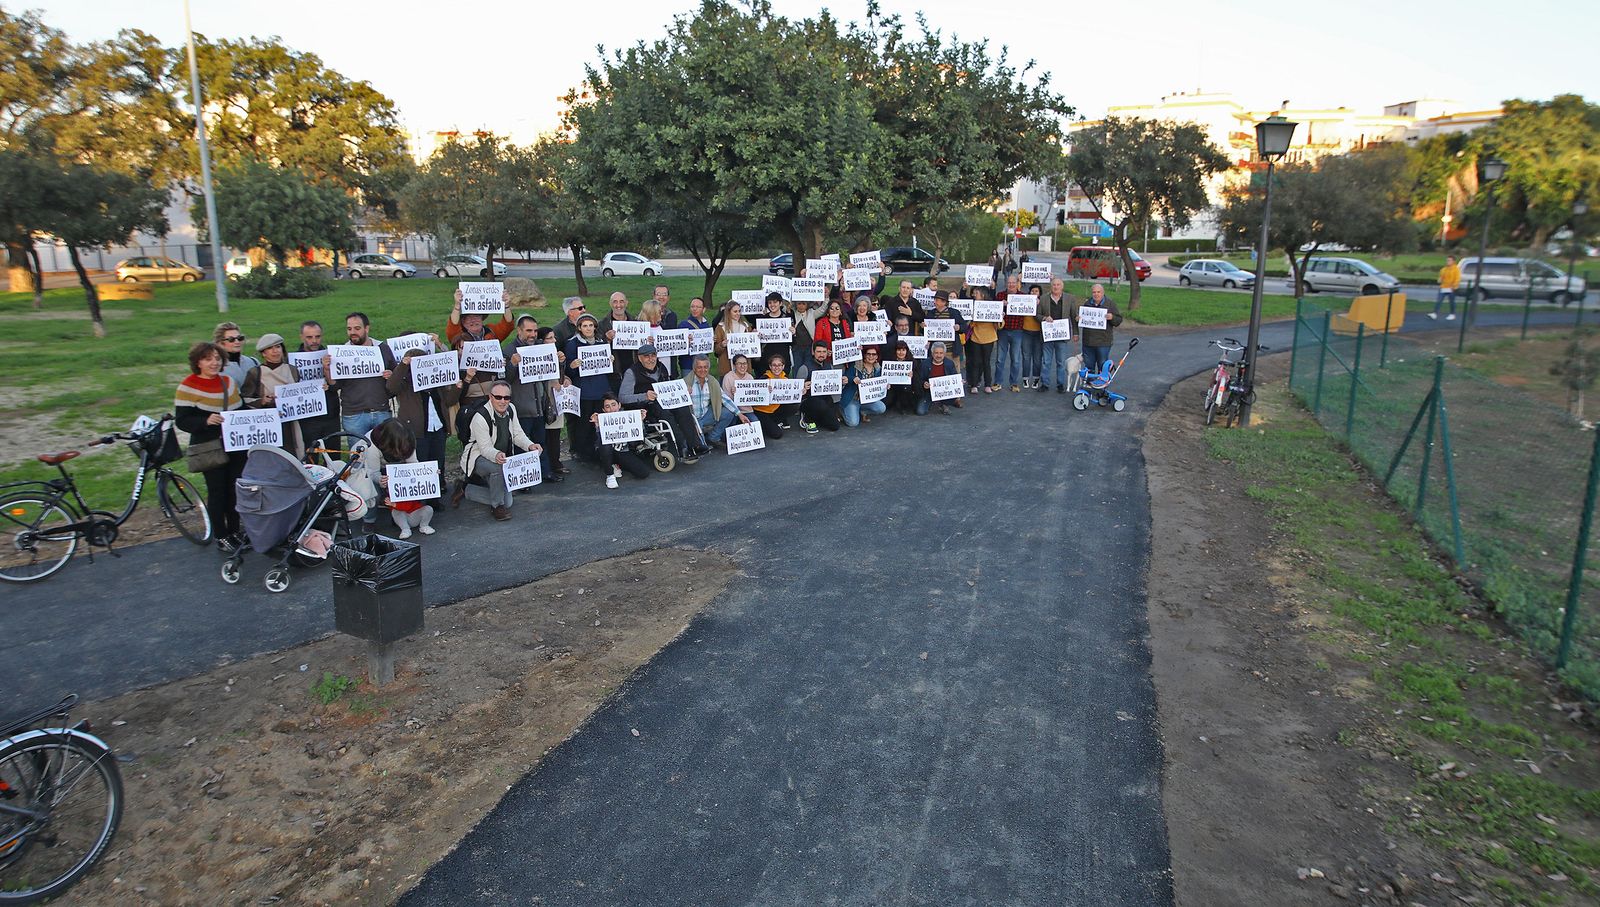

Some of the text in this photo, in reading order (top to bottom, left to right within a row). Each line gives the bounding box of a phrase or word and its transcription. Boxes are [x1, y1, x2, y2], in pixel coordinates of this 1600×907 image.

[466, 285, 500, 294] Zonas verdes
[464, 298, 501, 310] Sin asfalto
[745, 303, 763, 312] asfalto
[1018, 305, 1034, 313] asfalto
[985, 311, 1000, 319] asfalto
[617, 326, 637, 334] Albero
[936, 328, 952, 338] asfalto
[394, 339, 419, 351] Albero
[656, 342, 686, 352] BARBARIDAD
[336, 348, 375, 357] Zonas verdes
[582, 351, 592, 360] ESTO
[294, 359, 310, 368] ESTO
[417, 358, 434, 369] Zonas
[435, 356, 452, 366] verdes
[466, 356, 503, 368] Sin asfalto
[522, 356, 536, 365] ESTO
[581, 358, 610, 370] BARBARIDAD
[336, 362, 380, 375] Sin asfalto
[522, 363, 556, 377] BARBARIDAD
[418, 370, 456, 386] Sin asfalto
[281, 383, 319, 398] Zonas verdes
[658, 385, 677, 394] Albero
[814, 383, 839, 392] Sin asfalto
[681, 394, 688, 402] NO
[282, 398, 322, 418] Sin asfalto
[230, 412, 274, 426] Zonas verdes
[604, 413, 636, 426] Albero SI
[230, 429, 277, 446] Sin asfalto
[605, 428, 640, 441] Alquitran NO
[730, 426, 748, 438] Albero
[508, 454, 538, 470] Zonas verdes
[394, 466, 432, 478] Zonas verdes
[508, 468, 540, 487] Sin asfalto
[394, 481, 436, 498] Sin asfalto
